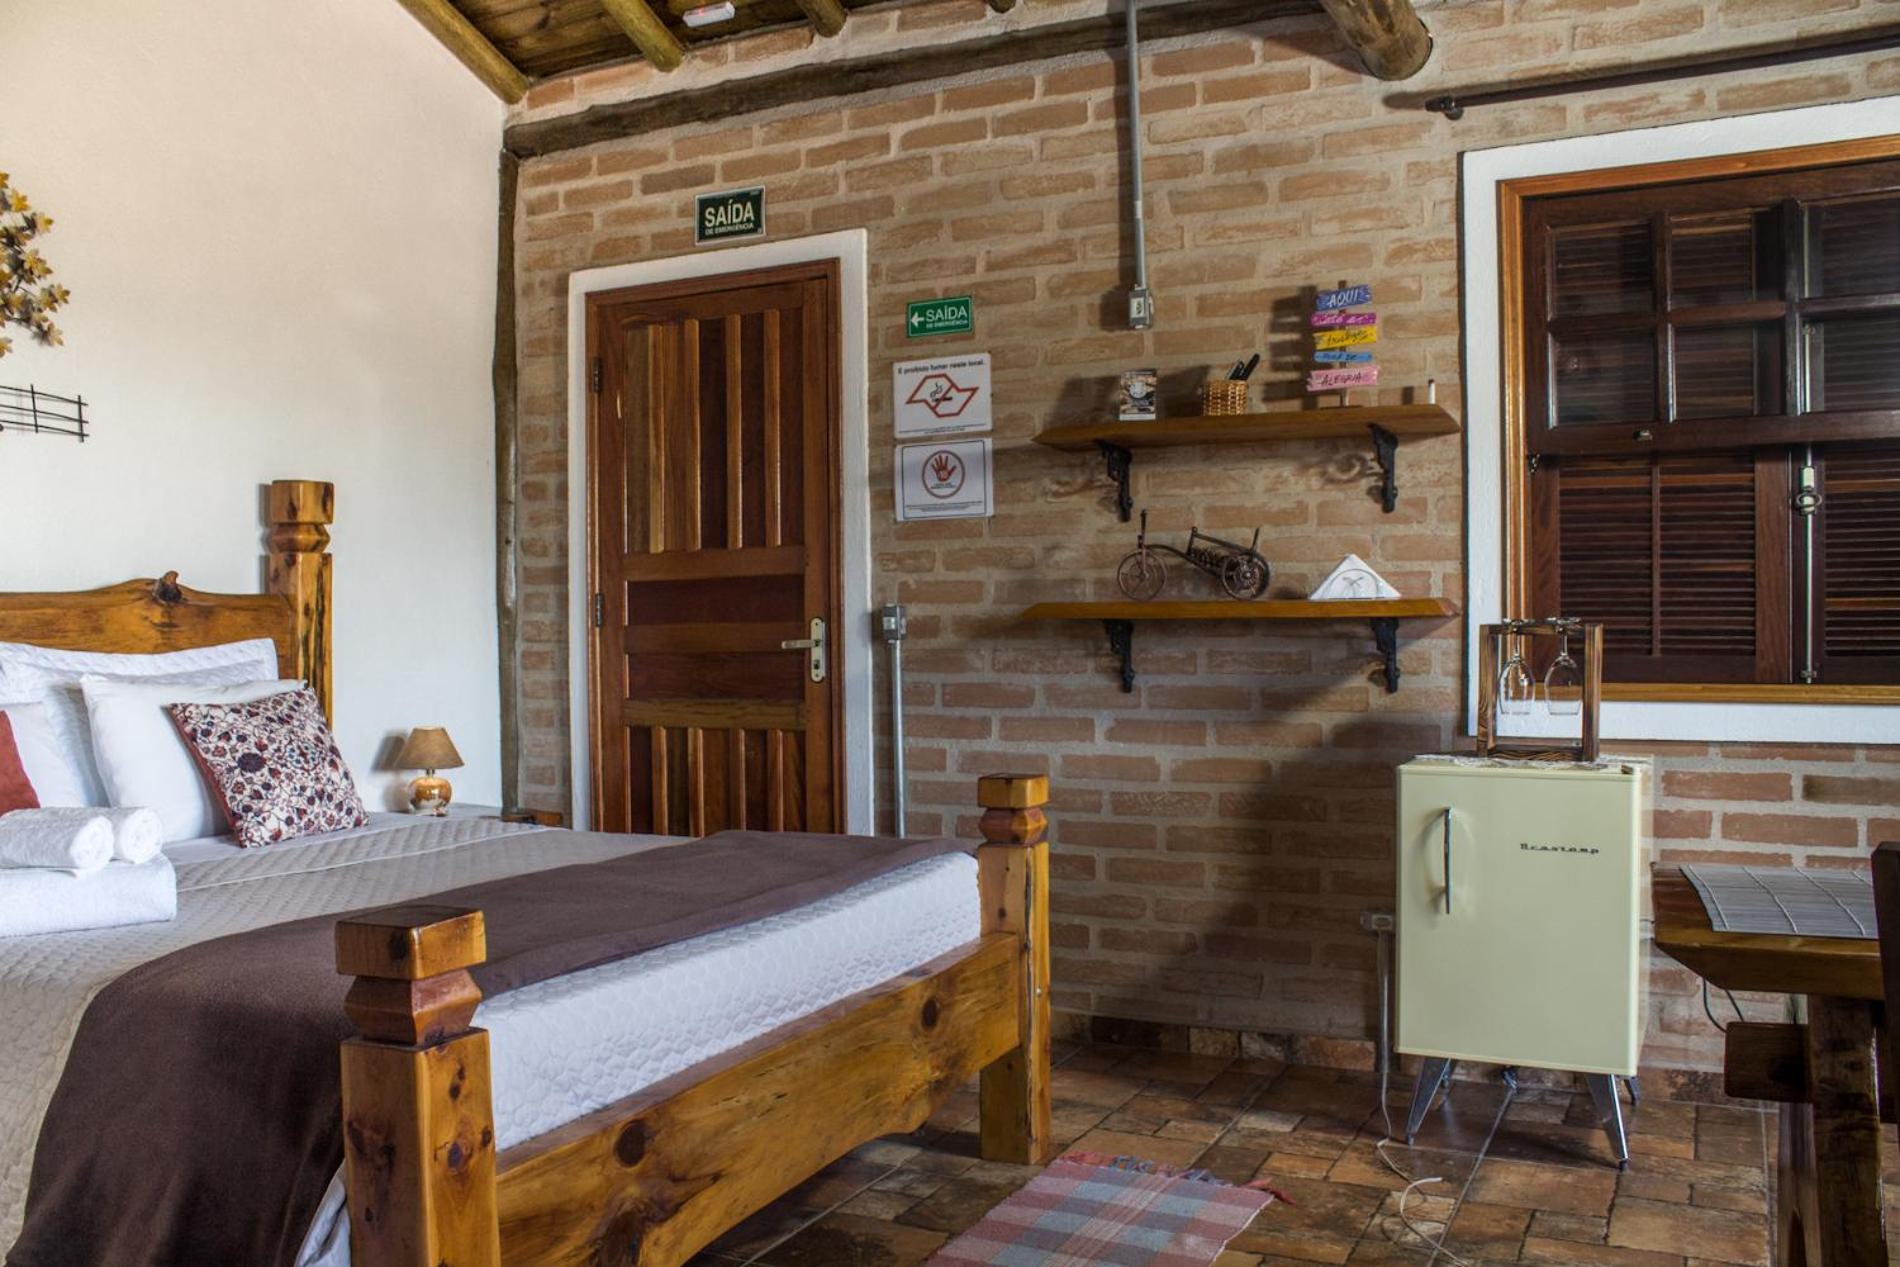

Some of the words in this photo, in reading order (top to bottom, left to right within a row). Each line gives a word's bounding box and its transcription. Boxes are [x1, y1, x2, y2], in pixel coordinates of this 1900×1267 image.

[705, 199, 755, 227] SAÍDA
[705, 228, 714, 236] DE
[1327, 288, 1359, 308] AQUI
[926, 305, 968, 322] SAÍDA
